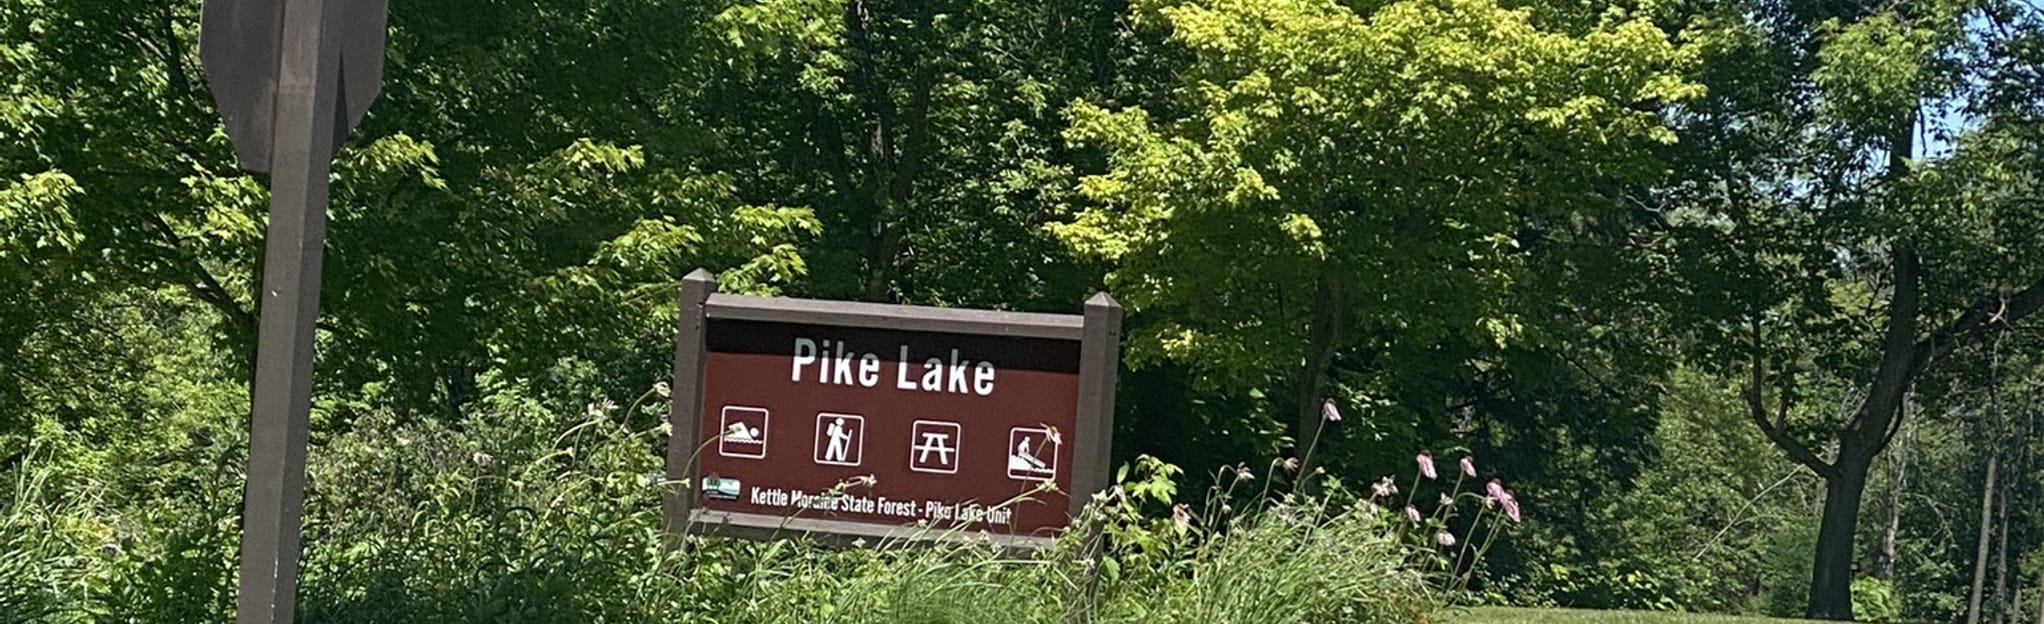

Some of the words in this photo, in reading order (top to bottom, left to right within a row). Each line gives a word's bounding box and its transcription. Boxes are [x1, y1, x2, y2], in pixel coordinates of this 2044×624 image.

[792, 337, 880, 387] Pike
[897, 345, 995, 395] Lake
[750, 486, 789, 506] Kettle
[840, 494, 875, 513] State
[877, 497, 917, 517] Forest
[925, 501, 952, 519] Pike
[954, 503, 983, 522] Lake
[986, 505, 1012, 524] Unit
